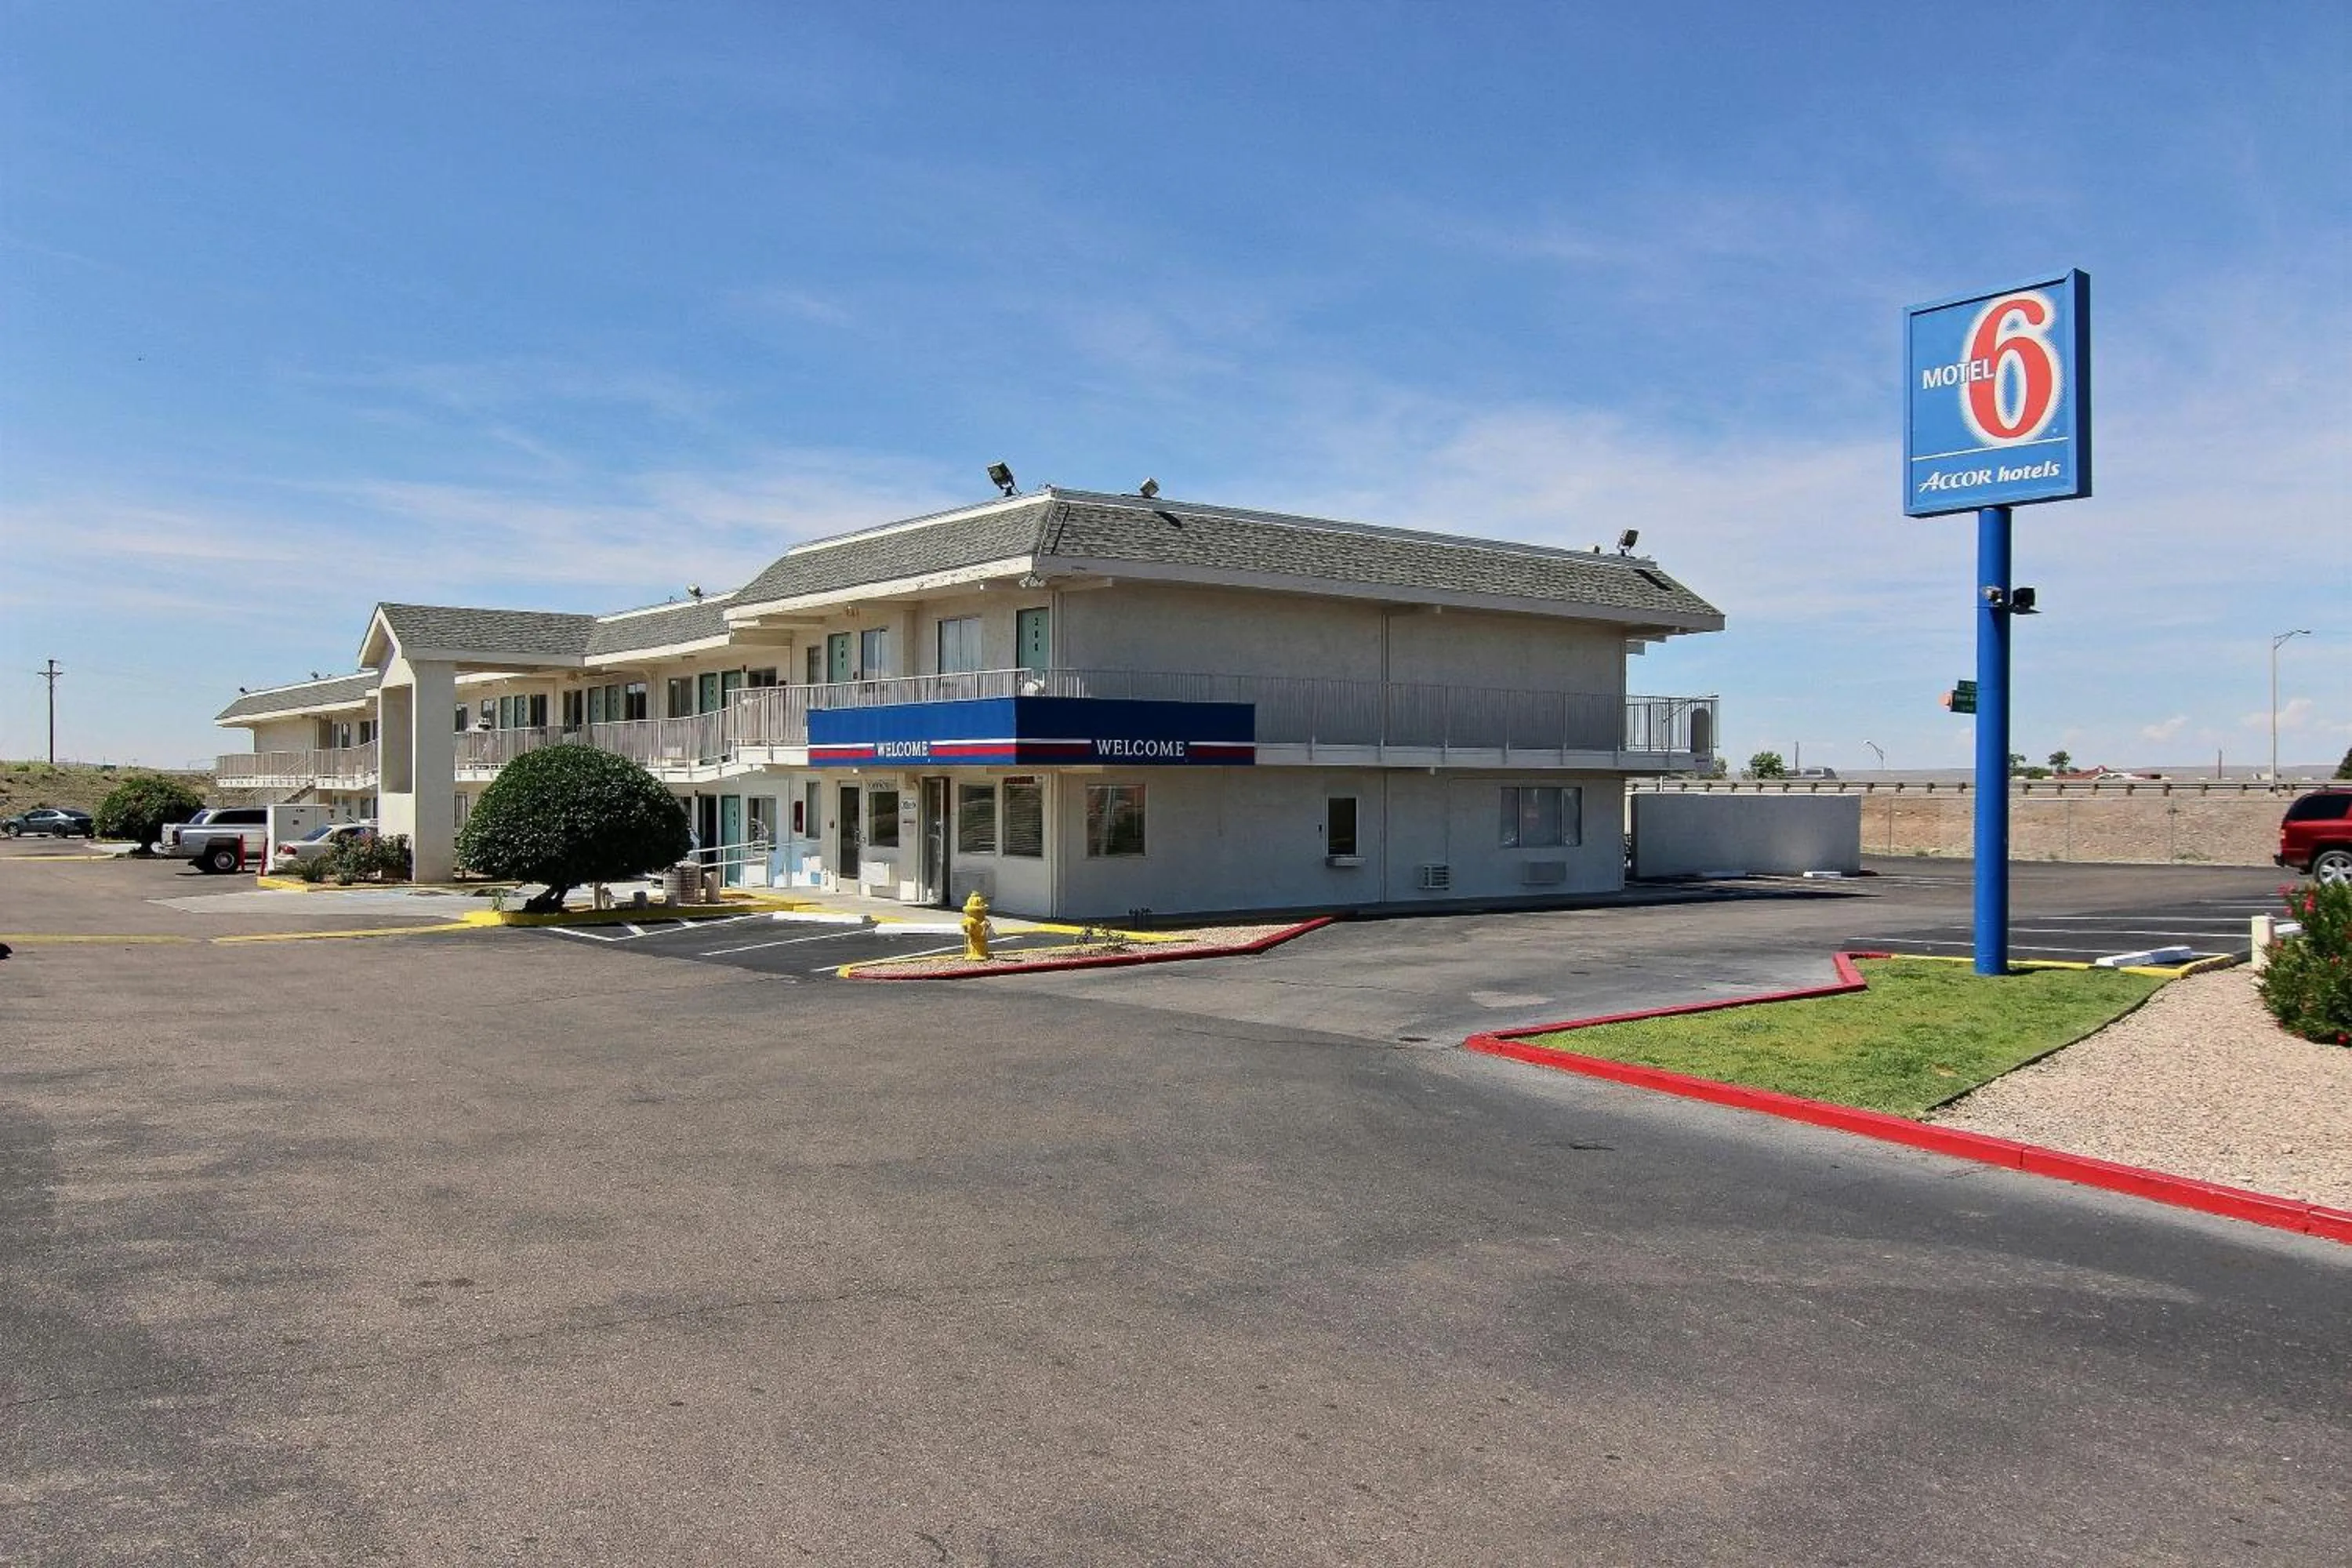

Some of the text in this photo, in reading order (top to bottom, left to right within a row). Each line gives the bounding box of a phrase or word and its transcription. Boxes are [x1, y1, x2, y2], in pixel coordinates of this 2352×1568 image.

[1922, 298, 2053, 438] MOTEL 6
[1918, 459, 2061, 492] ACCOR hotels
[877, 741, 928, 757] WELCOME
[1097, 739, 1185, 757] WELCOME
